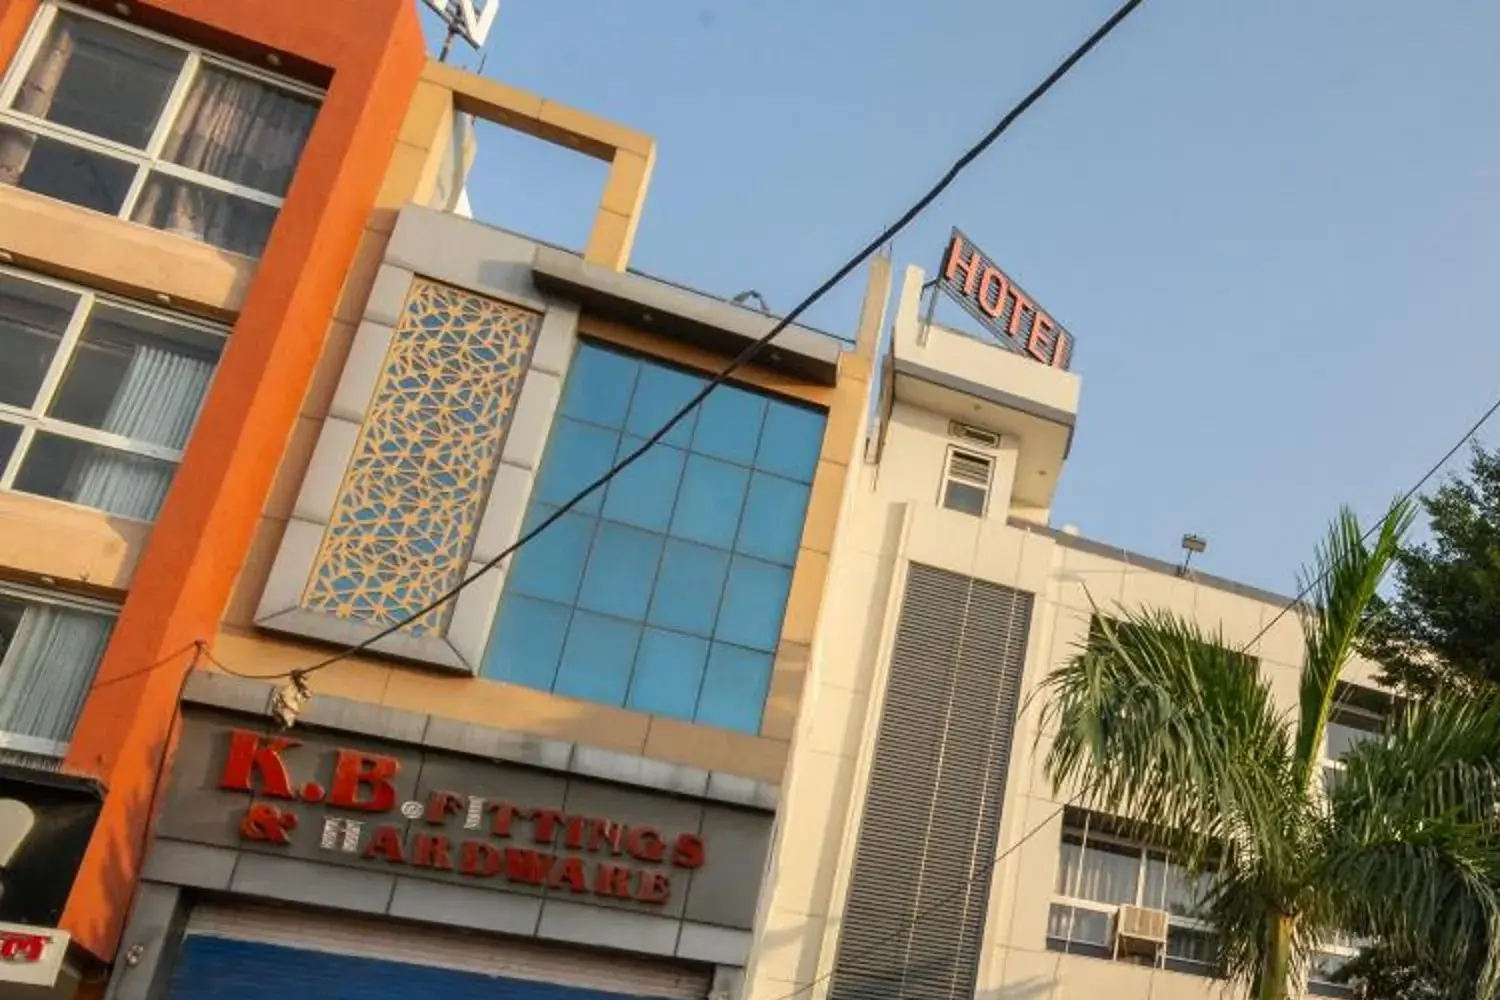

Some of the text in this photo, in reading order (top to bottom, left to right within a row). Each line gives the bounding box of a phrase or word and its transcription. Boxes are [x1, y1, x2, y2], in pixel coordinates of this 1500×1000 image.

[239, 802, 669, 905] & HARDWARE
[425, 790, 706, 868] FITTINGS
